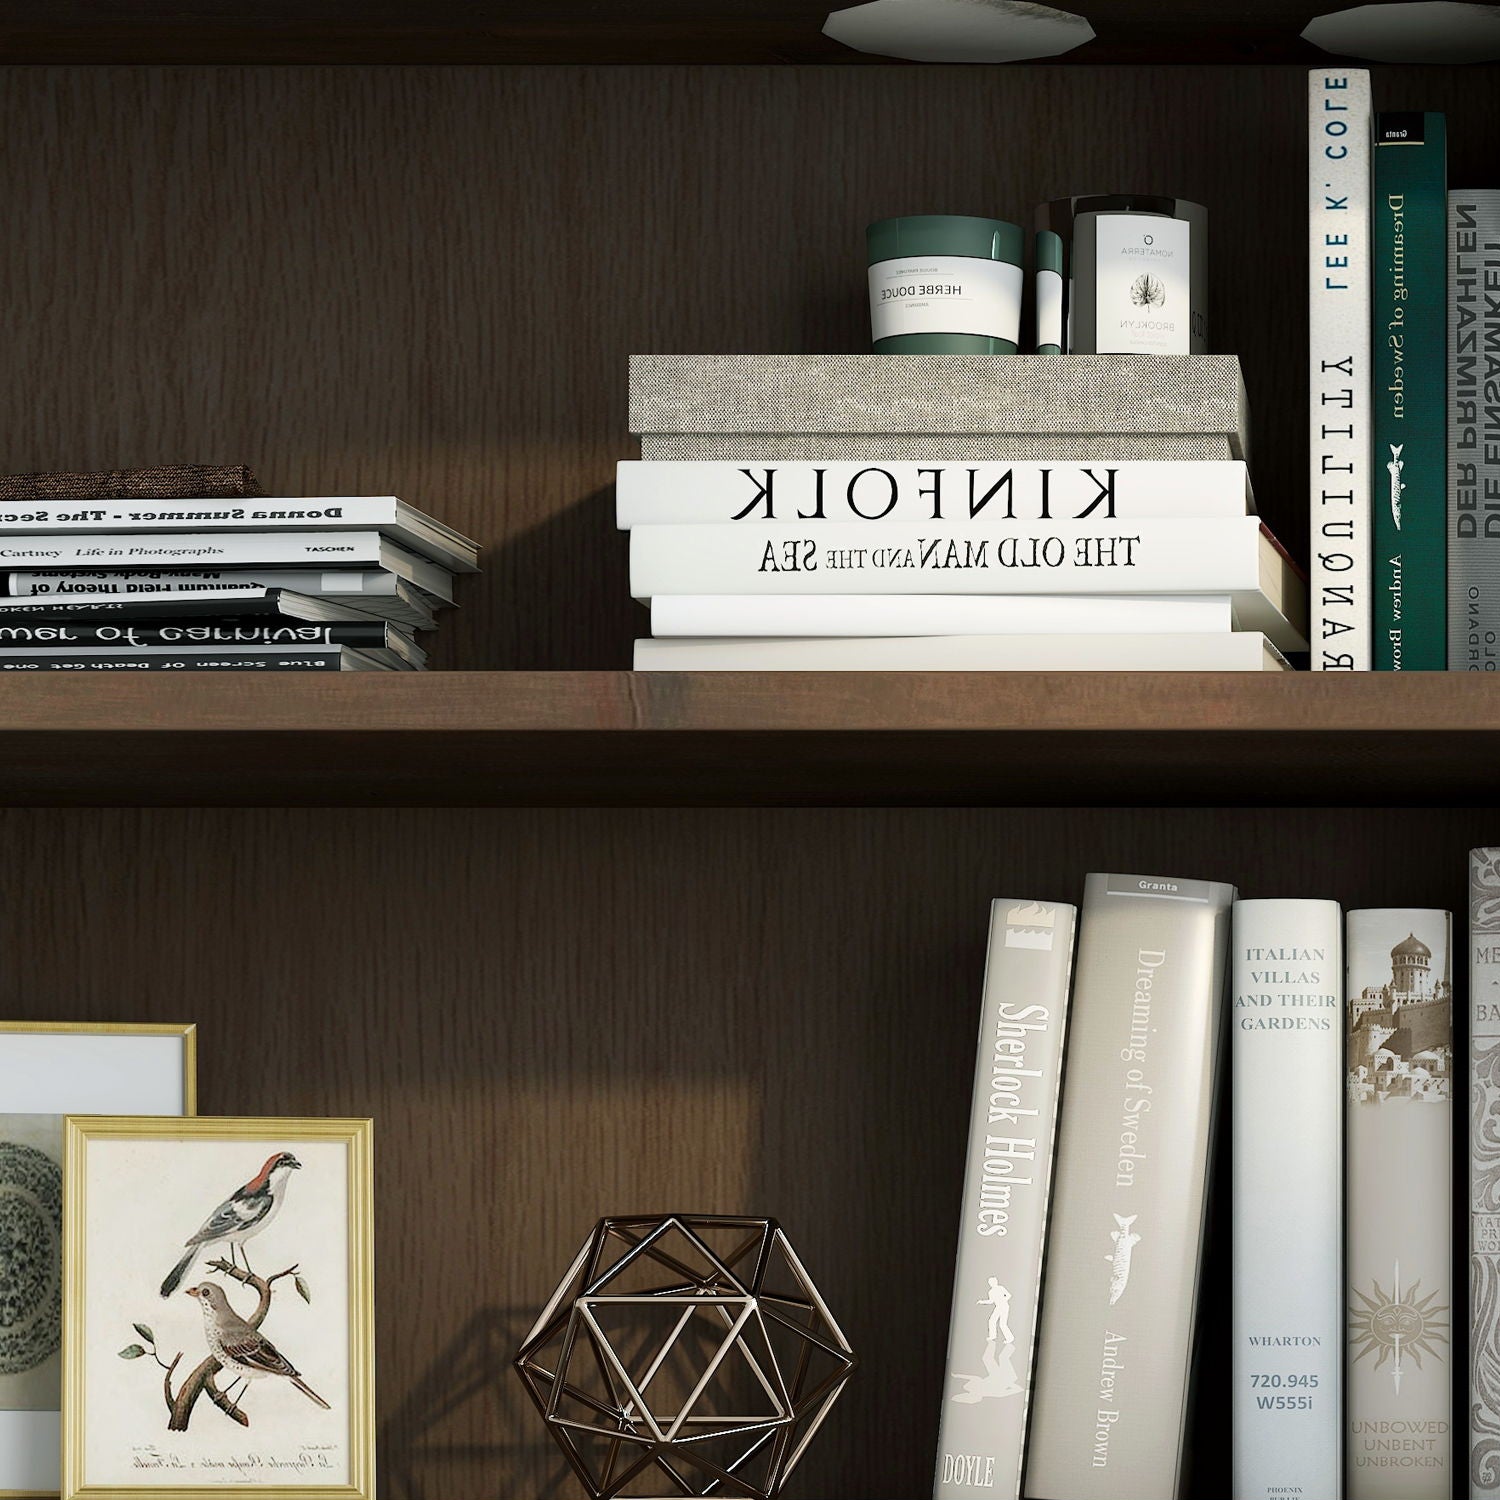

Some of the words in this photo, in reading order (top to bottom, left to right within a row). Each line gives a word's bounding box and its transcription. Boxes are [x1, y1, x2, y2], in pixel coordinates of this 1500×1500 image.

[0, 549, 63, 558] Cartney
[75, 548, 105, 556] Life
[108, 548, 123, 556] in
[128, 546, 224, 557] Photographs
[30, 583, 50, 596] of
[56, 581, 120, 594] Theory
[1138, 879, 1178, 892] Granta
[1246, 948, 1325, 961] ITALIAN
[1251, 971, 1320, 984] VILLAS
[1120, 948, 1166, 1063] Dreaming
[1234, 994, 1273, 1008] AND
[1277, 994, 1336, 1008] THEIR
[1241, 1017, 1330, 1031] GARDENS
[987, 1002, 1049, 1125] Sherlock
[1125, 1068, 1153, 1095] of
[1116, 1097, 1152, 1188] Sweden
[976, 1134, 1037, 1237] Holmes
[1249, 1336, 1321, 1346] WHARTON
[1099, 1329, 1128, 1403] Andrew
[1250, 1374, 1319, 1388] 720.945
[1256, 1395, 1313, 1410] W555i
[1351, 1421, 1449, 1434] UNBOWED
[1092, 1408, 1120, 1468] Brown
[1364, 1439, 1437, 1451] UNBENT
[1356, 1456, 1444, 1467] UNBROKEN
[942, 1453, 996, 1488] DOYLE
